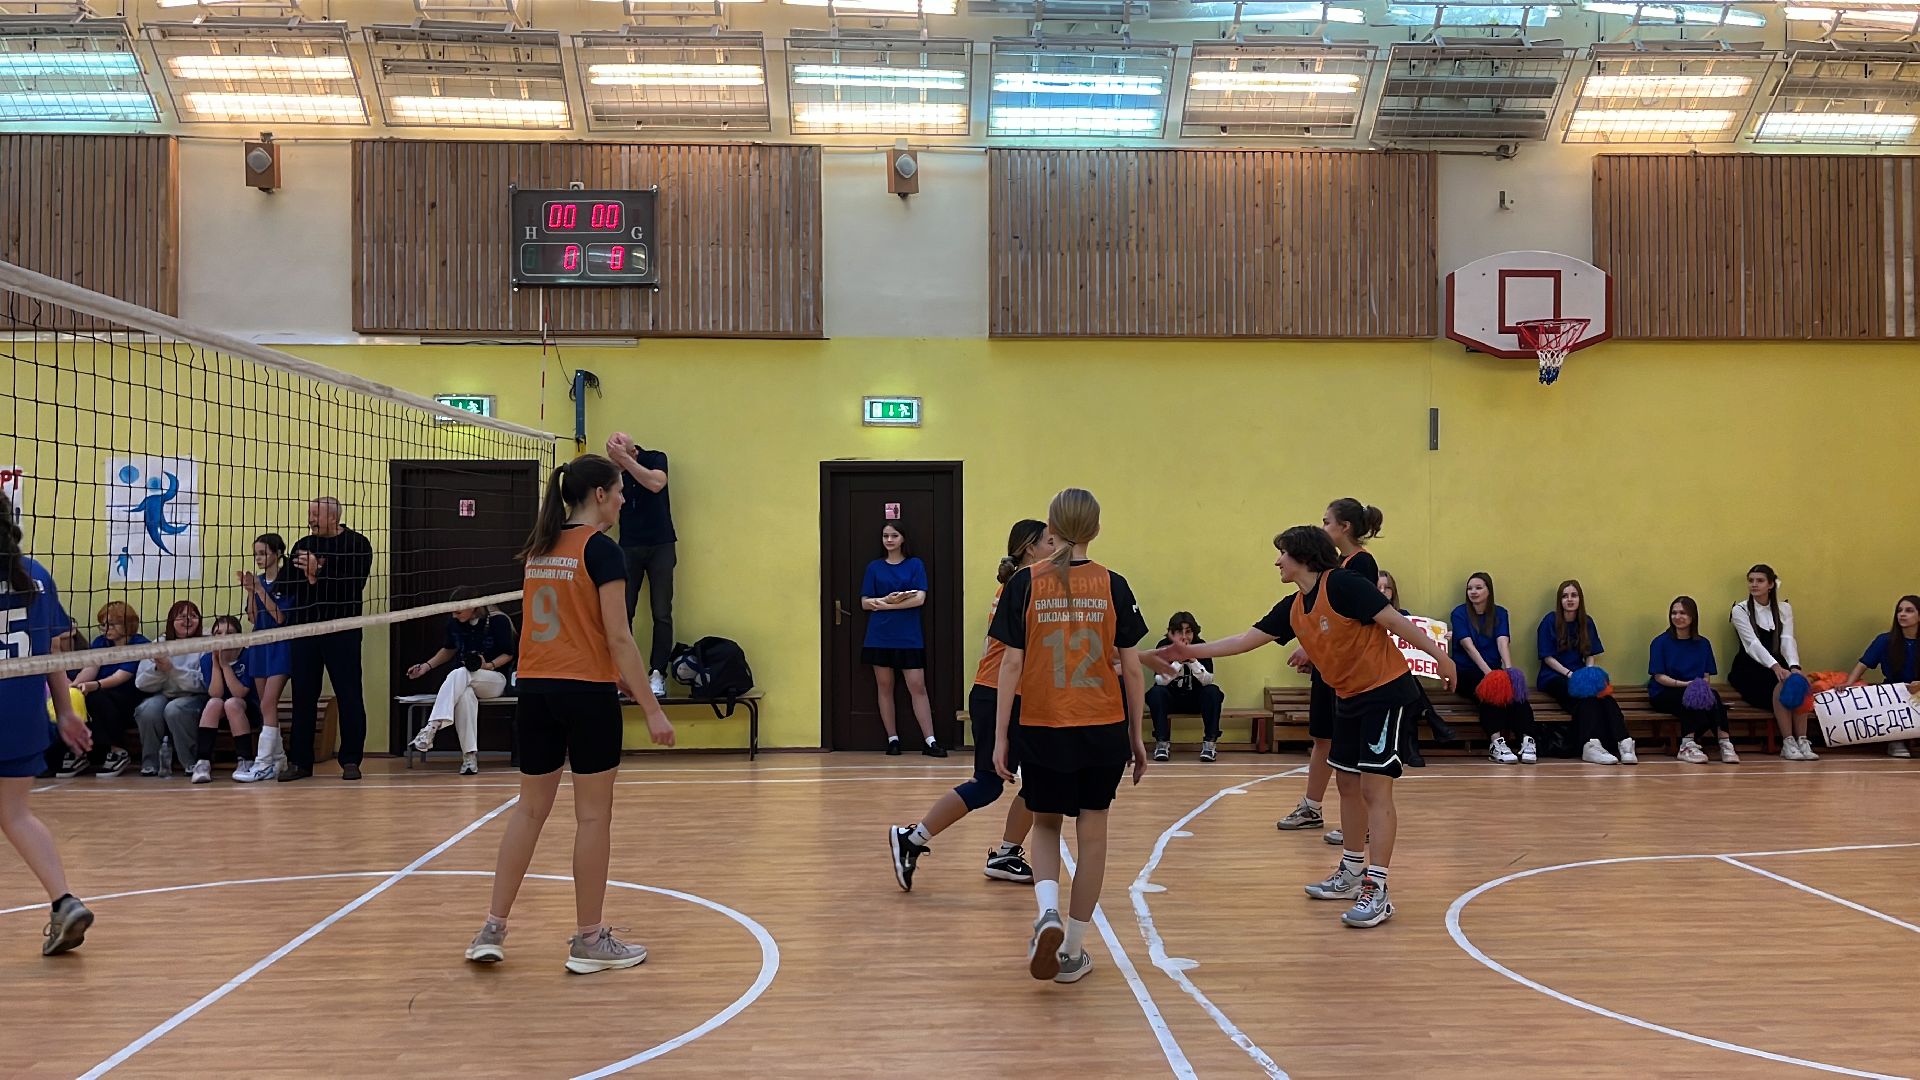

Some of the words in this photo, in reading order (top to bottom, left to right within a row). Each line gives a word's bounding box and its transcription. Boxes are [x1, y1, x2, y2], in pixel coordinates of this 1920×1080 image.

[549, 204, 577, 229] 00
[592, 204, 619, 228] 00
[525, 226, 537, 240] H
[631, 226, 643, 240] G
[564, 246, 578, 270] 0
[532, 586, 560, 642] 9
[1043, 628, 1103, 688] 12
[1826, 726, 1842, 745] К
[1844, 707, 1914, 742] ПОБЕДЕ!
